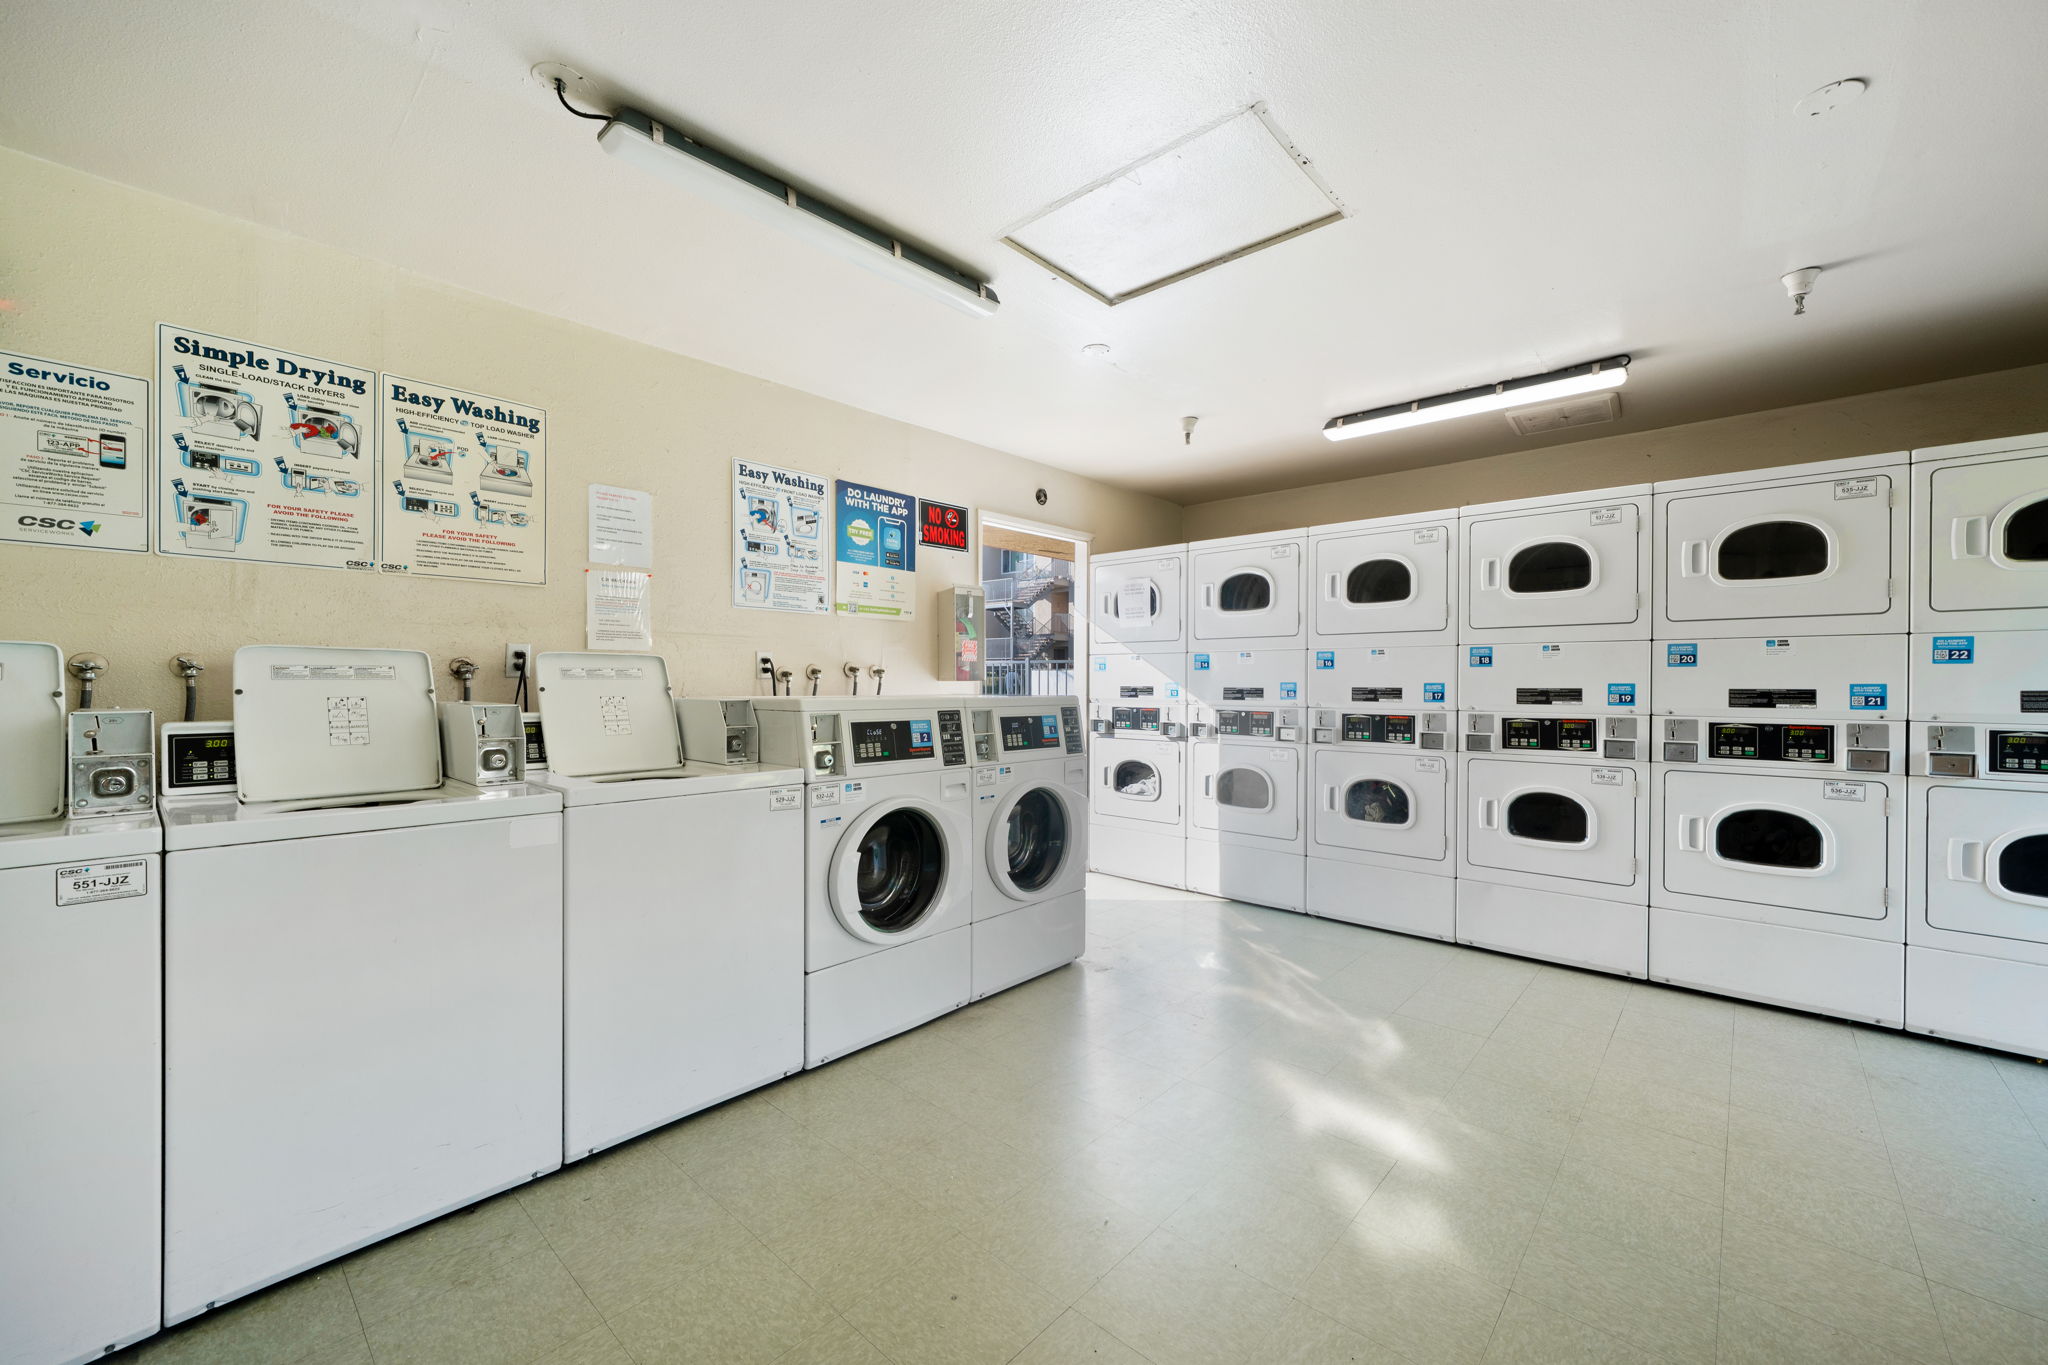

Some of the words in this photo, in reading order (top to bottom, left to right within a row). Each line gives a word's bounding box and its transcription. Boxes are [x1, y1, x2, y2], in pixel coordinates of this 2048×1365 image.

[174, 335, 269, 376] Simple
[276, 357, 366, 396] Drying
[8, 361, 110, 392] Servicio
[199, 364, 304, 391] SINGLE-LOAD/STACK
[307, 386, 345, 400] DRYERS
[18, 391, 52, 401] MAQUINAS
[62, 399, 89, 407] NUESTRA
[90, 404, 122, 413] PRIORIDAD
[20, 386, 76, 400] FUNCIONAMIENTO
[78, 396, 112, 406] APROPIADO
[46, 386, 85, 397] IMPORTANTE
[103, 396, 134, 405] NOSOTROS
[41, 407, 70, 416] CUALQUIER
[392, 384, 445, 415] Easy
[450, 396, 540, 435] Washing
[395, 406, 459, 425] HIGH-EFFICIENCY
[470, 422, 484, 430] TOP
[486, 425, 504, 434] LOAD
[506, 429, 534, 440] WASHER
[46, 439, 80, 449] 123-APP
[739, 464, 769, 485] Easy
[772, 470, 824, 496] Washing
[845, 496, 869, 510] WITH
[871, 502, 889, 514] THE
[891, 506, 908, 517] APP
[847, 487, 861, 499] DO
[864, 491, 905, 508] LAUNDRY
[18, 515, 75, 530] CSC
[311, 514, 348, 522] FOLLOWING
[928, 506, 941, 524] NO
[482, 539, 516, 547] FOLLOWING
[923, 524, 965, 547] SMOKING
[1951, 651, 1968, 659] 22
[922, 733, 928, 742] 2
[73, 875, 129, 890] 551-JJZ
